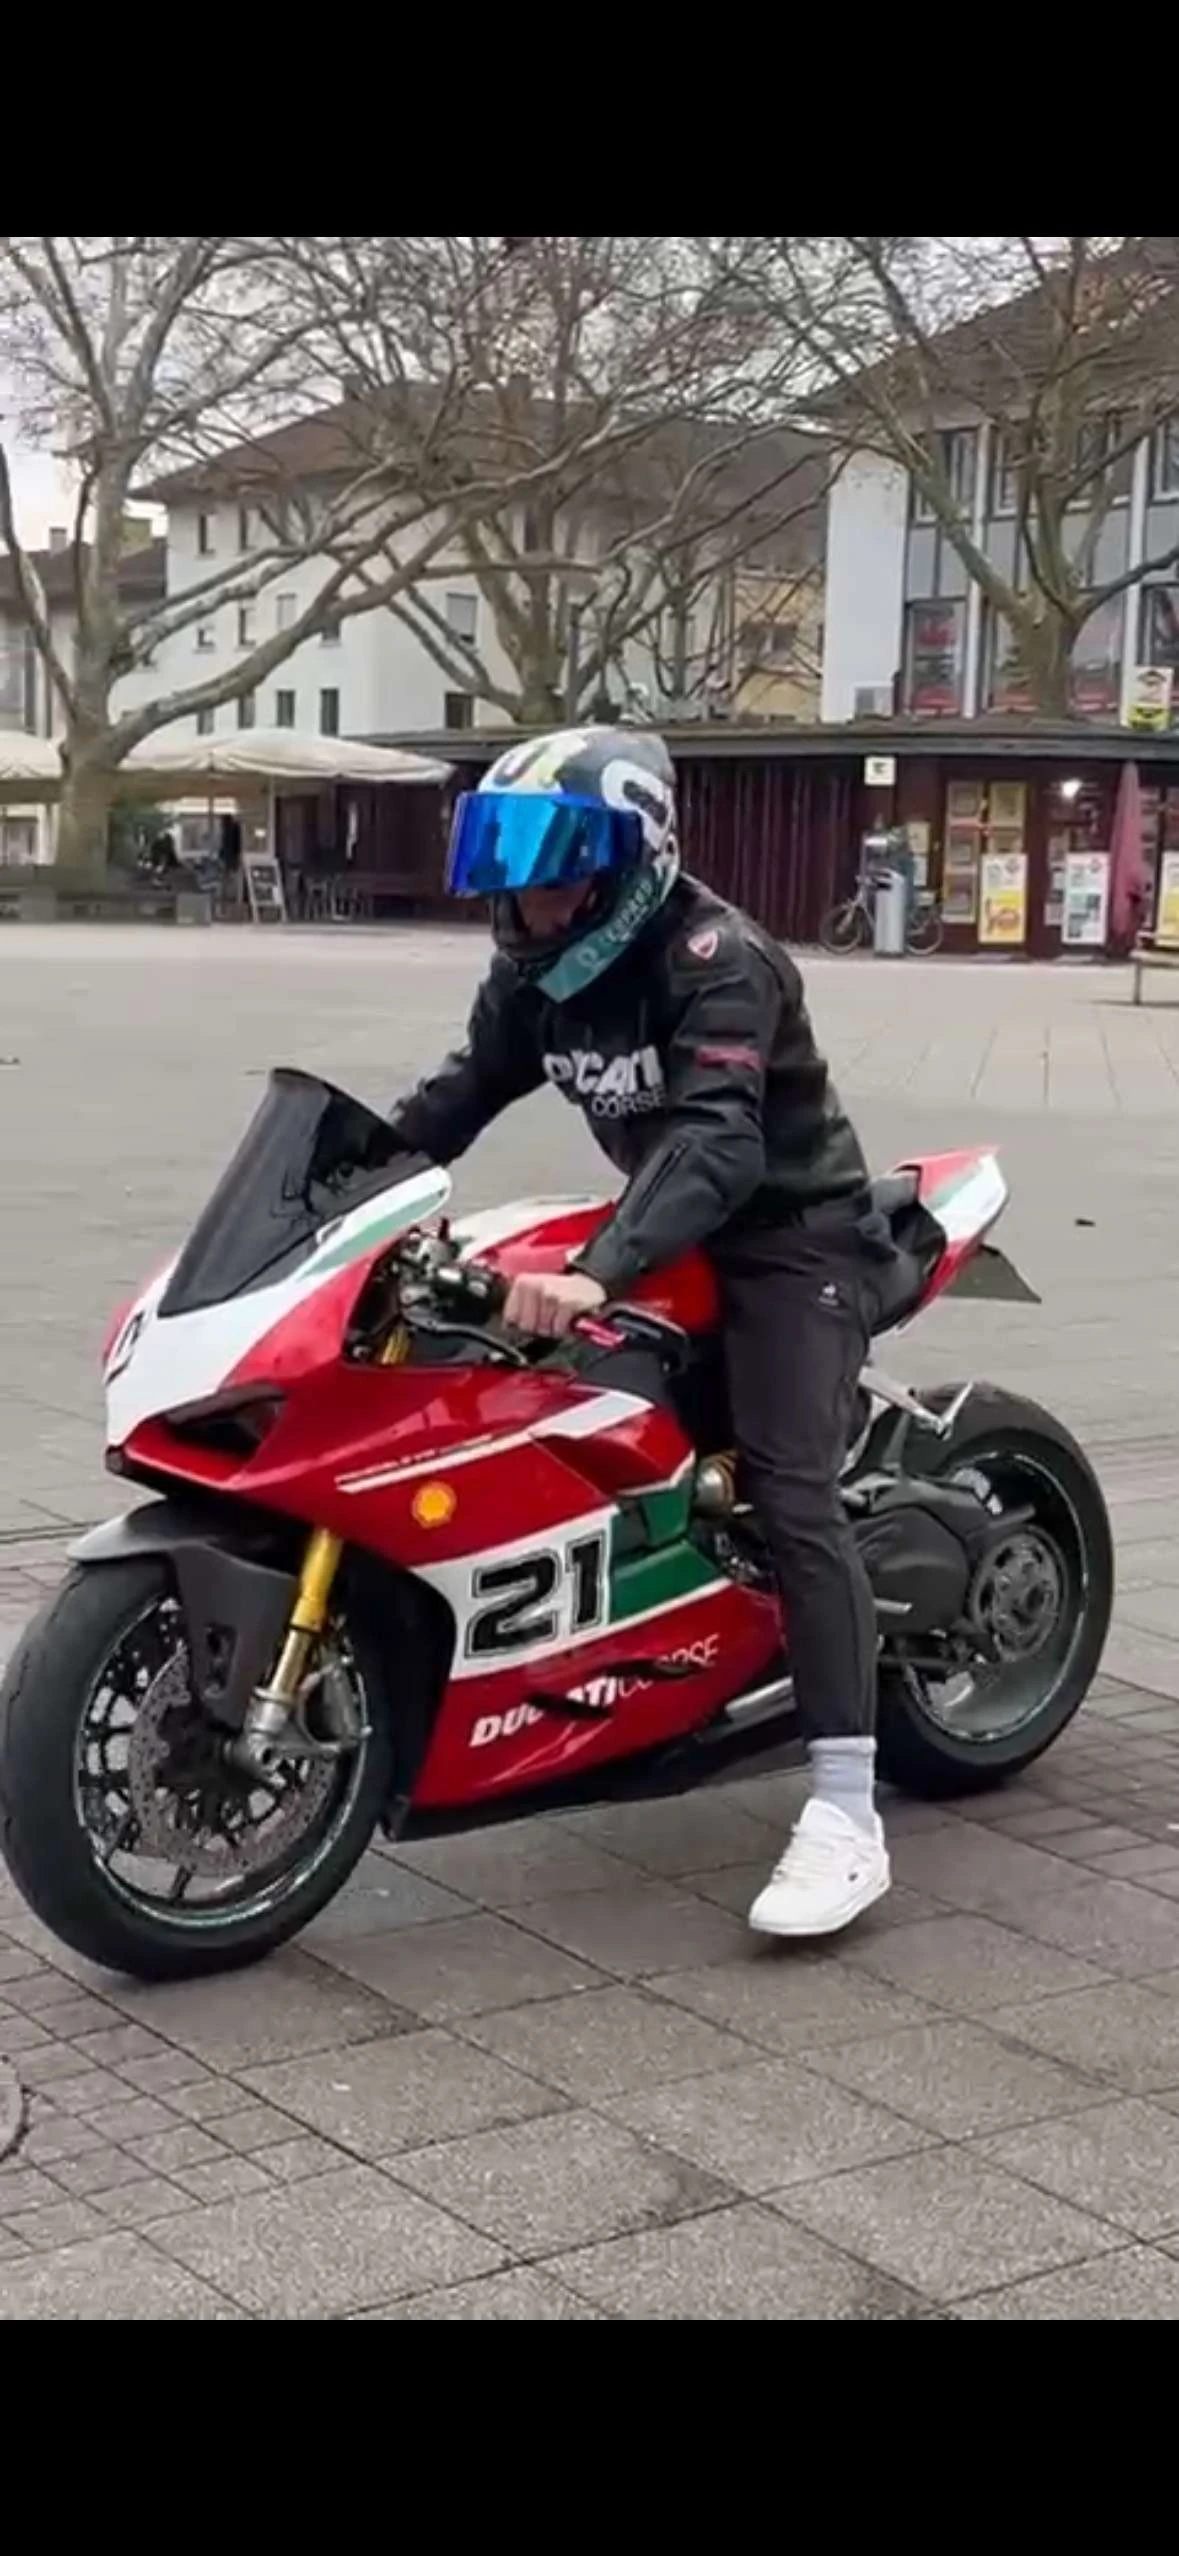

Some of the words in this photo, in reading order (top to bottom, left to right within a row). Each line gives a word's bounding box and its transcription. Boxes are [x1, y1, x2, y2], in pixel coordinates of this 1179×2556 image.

[542, 1045, 664, 1095] DCATI
[591, 1085, 664, 1118] CORSE
[464, 1529, 606, 1659] 21
